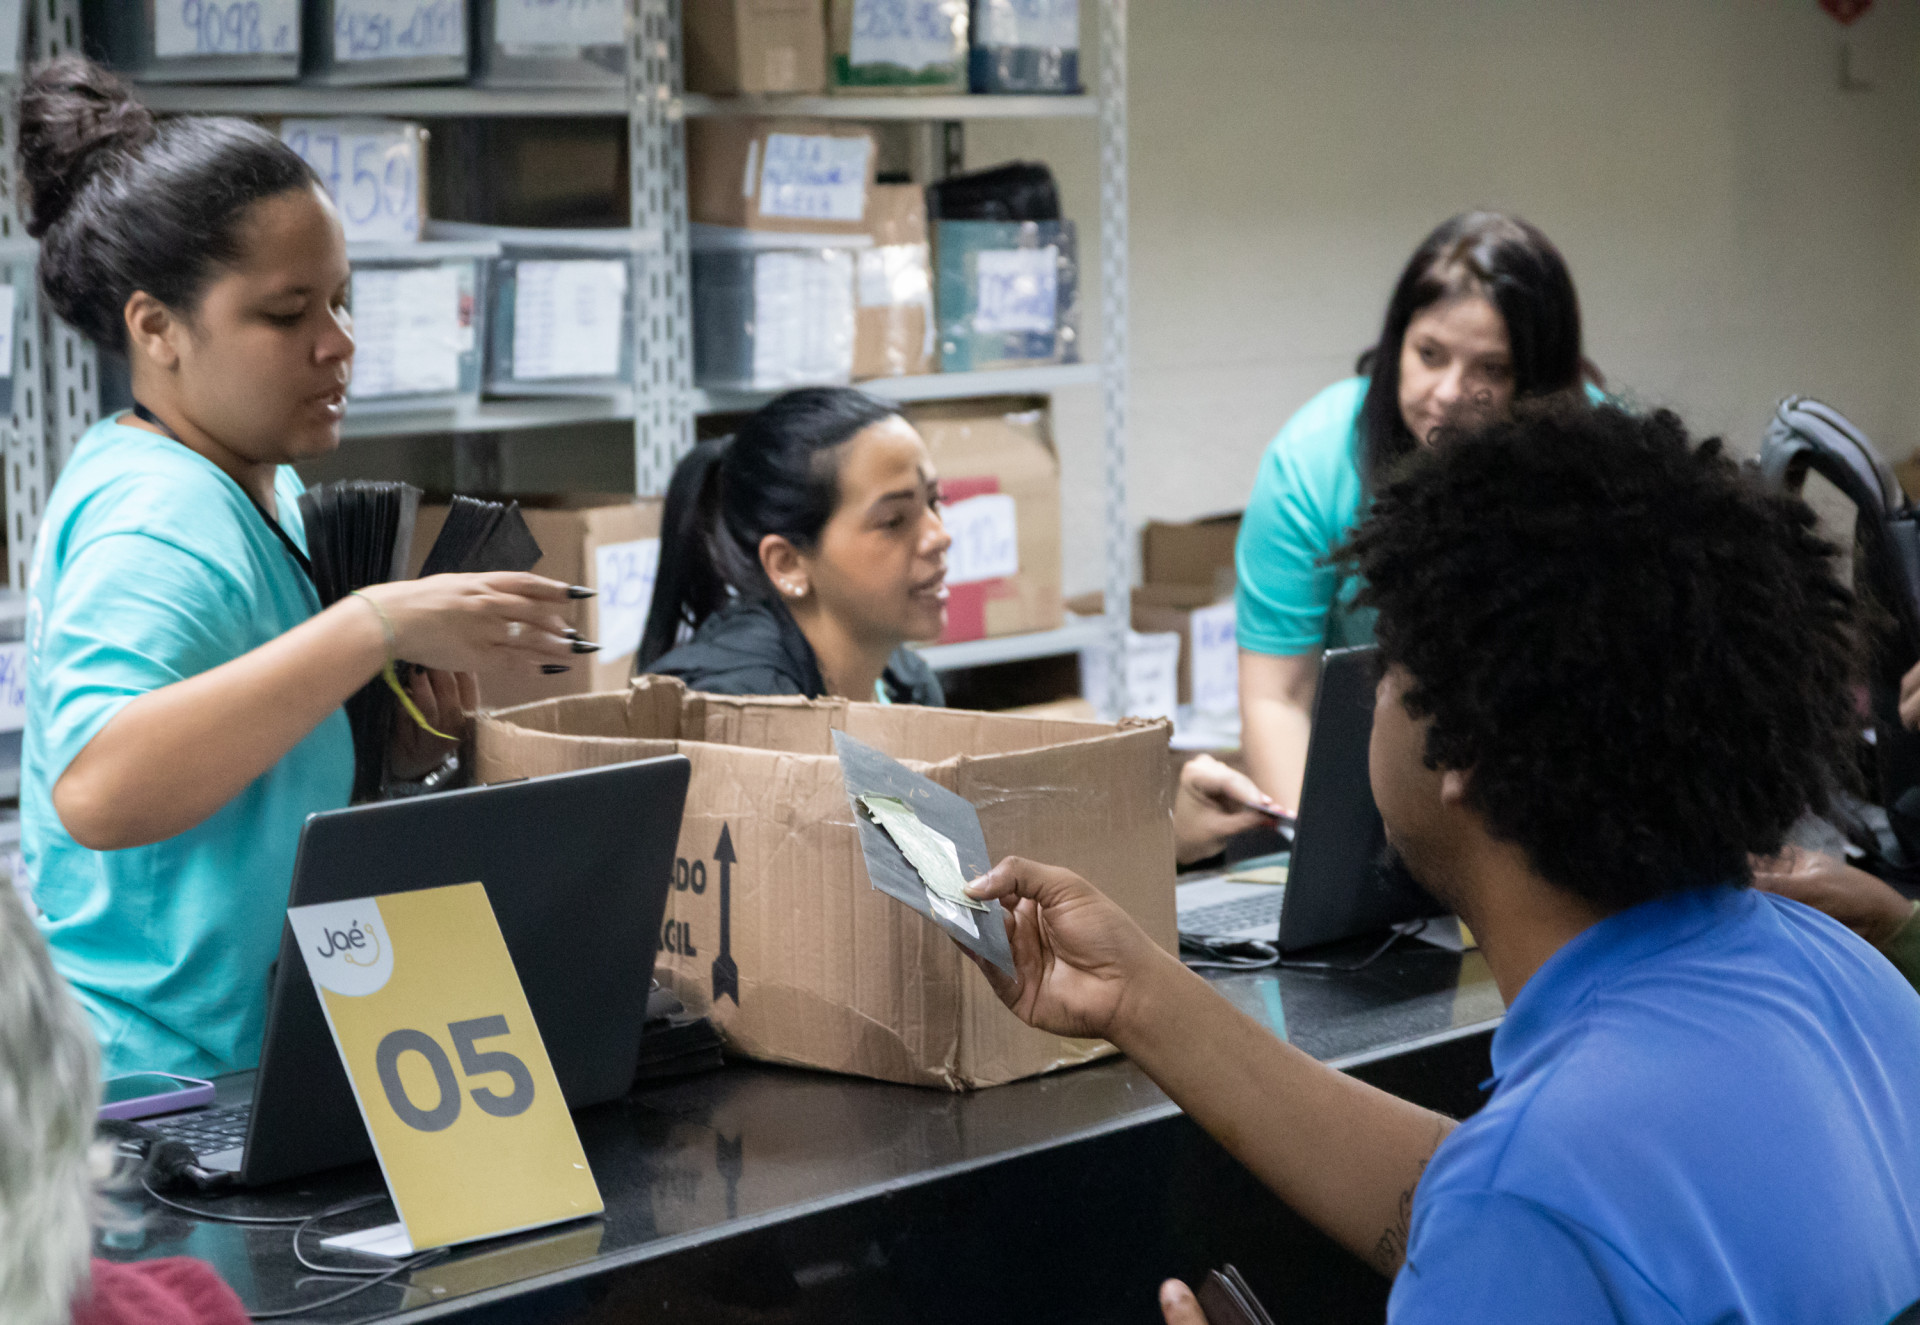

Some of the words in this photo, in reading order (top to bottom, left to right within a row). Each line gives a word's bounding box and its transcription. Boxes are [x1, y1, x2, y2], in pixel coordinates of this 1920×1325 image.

[669, 857, 707, 896] DO
[317, 919, 366, 958] Jaé
[657, 918, 697, 957] GIL
[376, 1014, 535, 1133] 05
